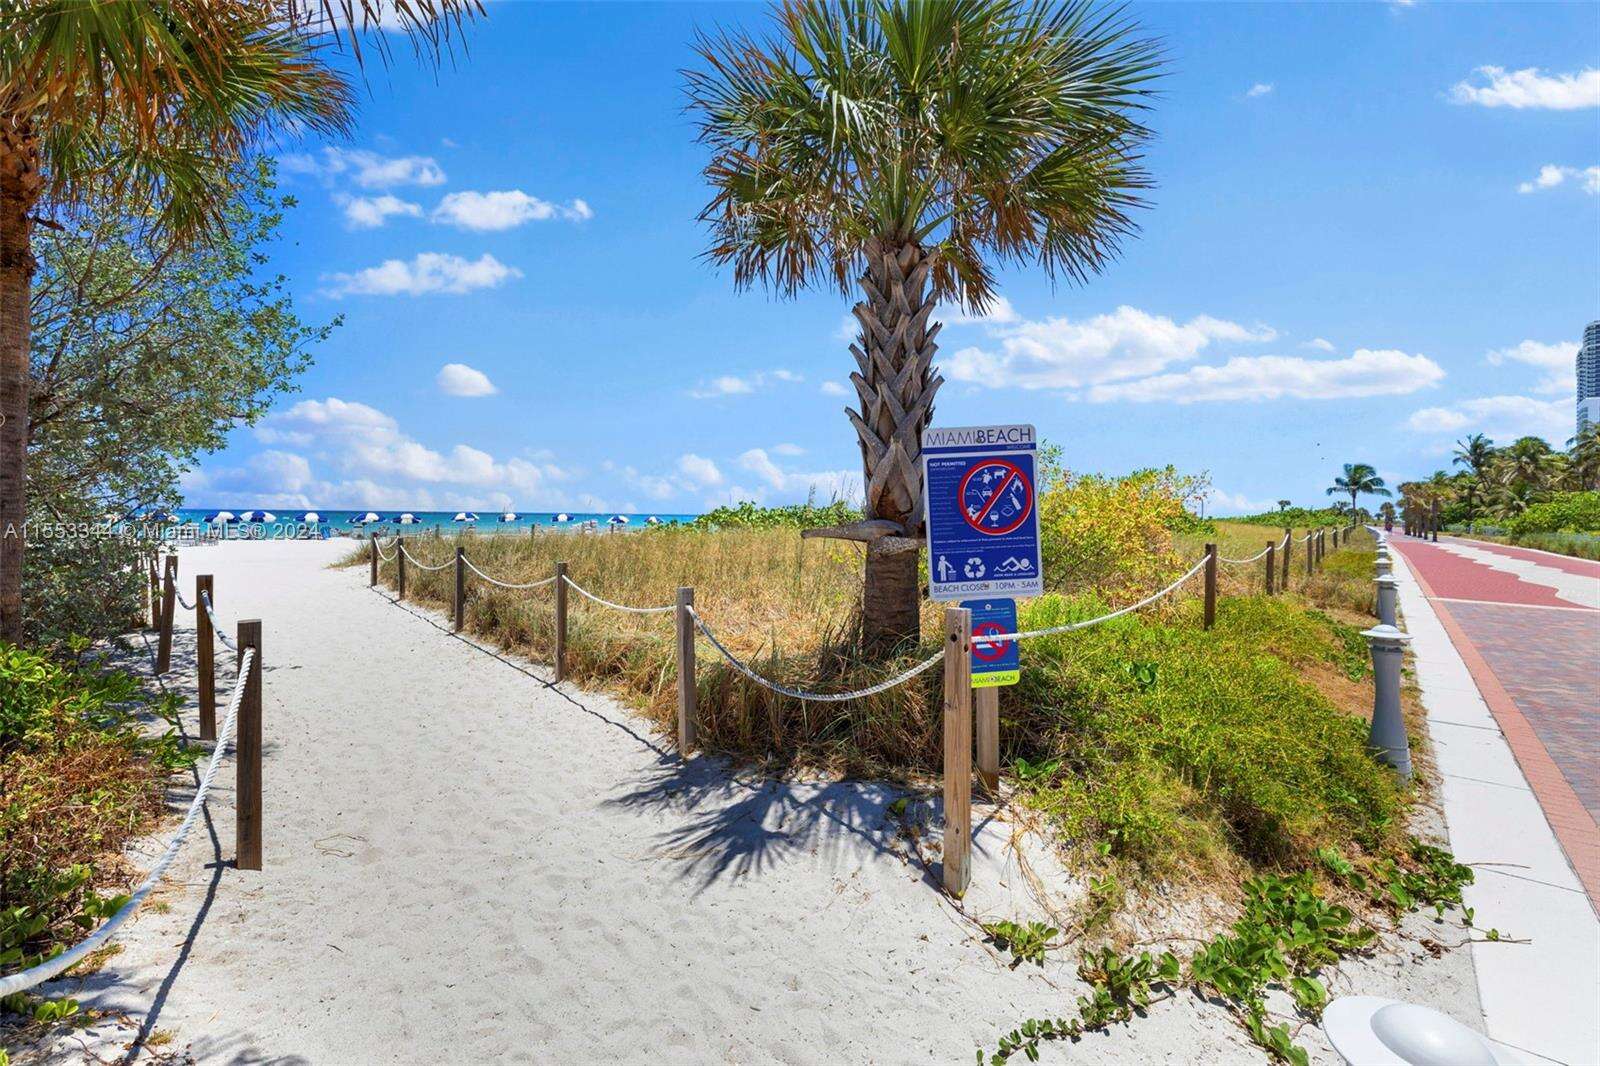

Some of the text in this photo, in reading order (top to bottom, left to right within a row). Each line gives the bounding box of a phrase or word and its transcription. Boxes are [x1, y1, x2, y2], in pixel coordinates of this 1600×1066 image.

[933, 584, 959, 593] BEACH
[995, 581, 1016, 590] 10PM
[1021, 581, 1039, 589] 5AM
